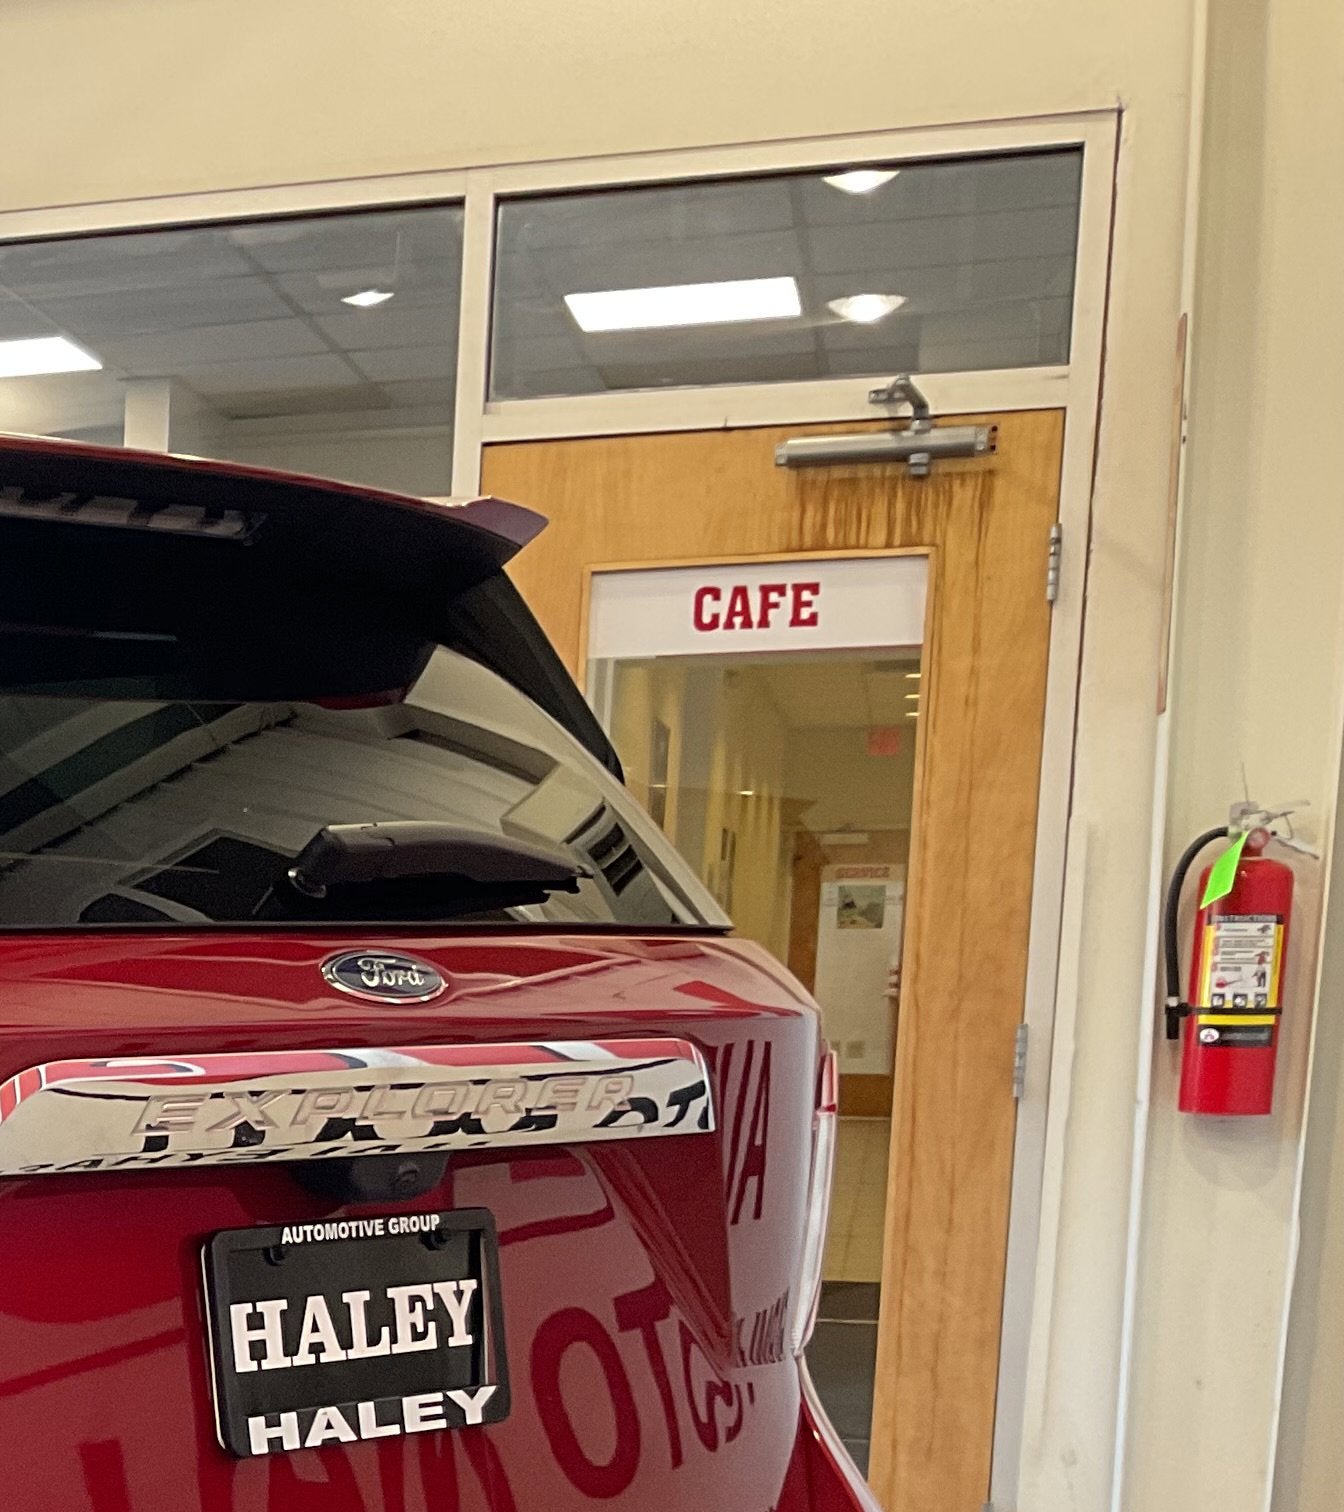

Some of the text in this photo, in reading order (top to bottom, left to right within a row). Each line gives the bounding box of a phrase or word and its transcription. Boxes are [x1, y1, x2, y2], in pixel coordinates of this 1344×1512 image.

[693, 581, 821, 632] CAFE
[357, 958, 425, 988] Ford
[129, 1072, 636, 1137] EXPLORER
[281, 1214, 440, 1245] AUTOMOTIVE GROUP
[229, 1279, 478, 1374] HALEY
[247, 1385, 498, 1456] HALEY
